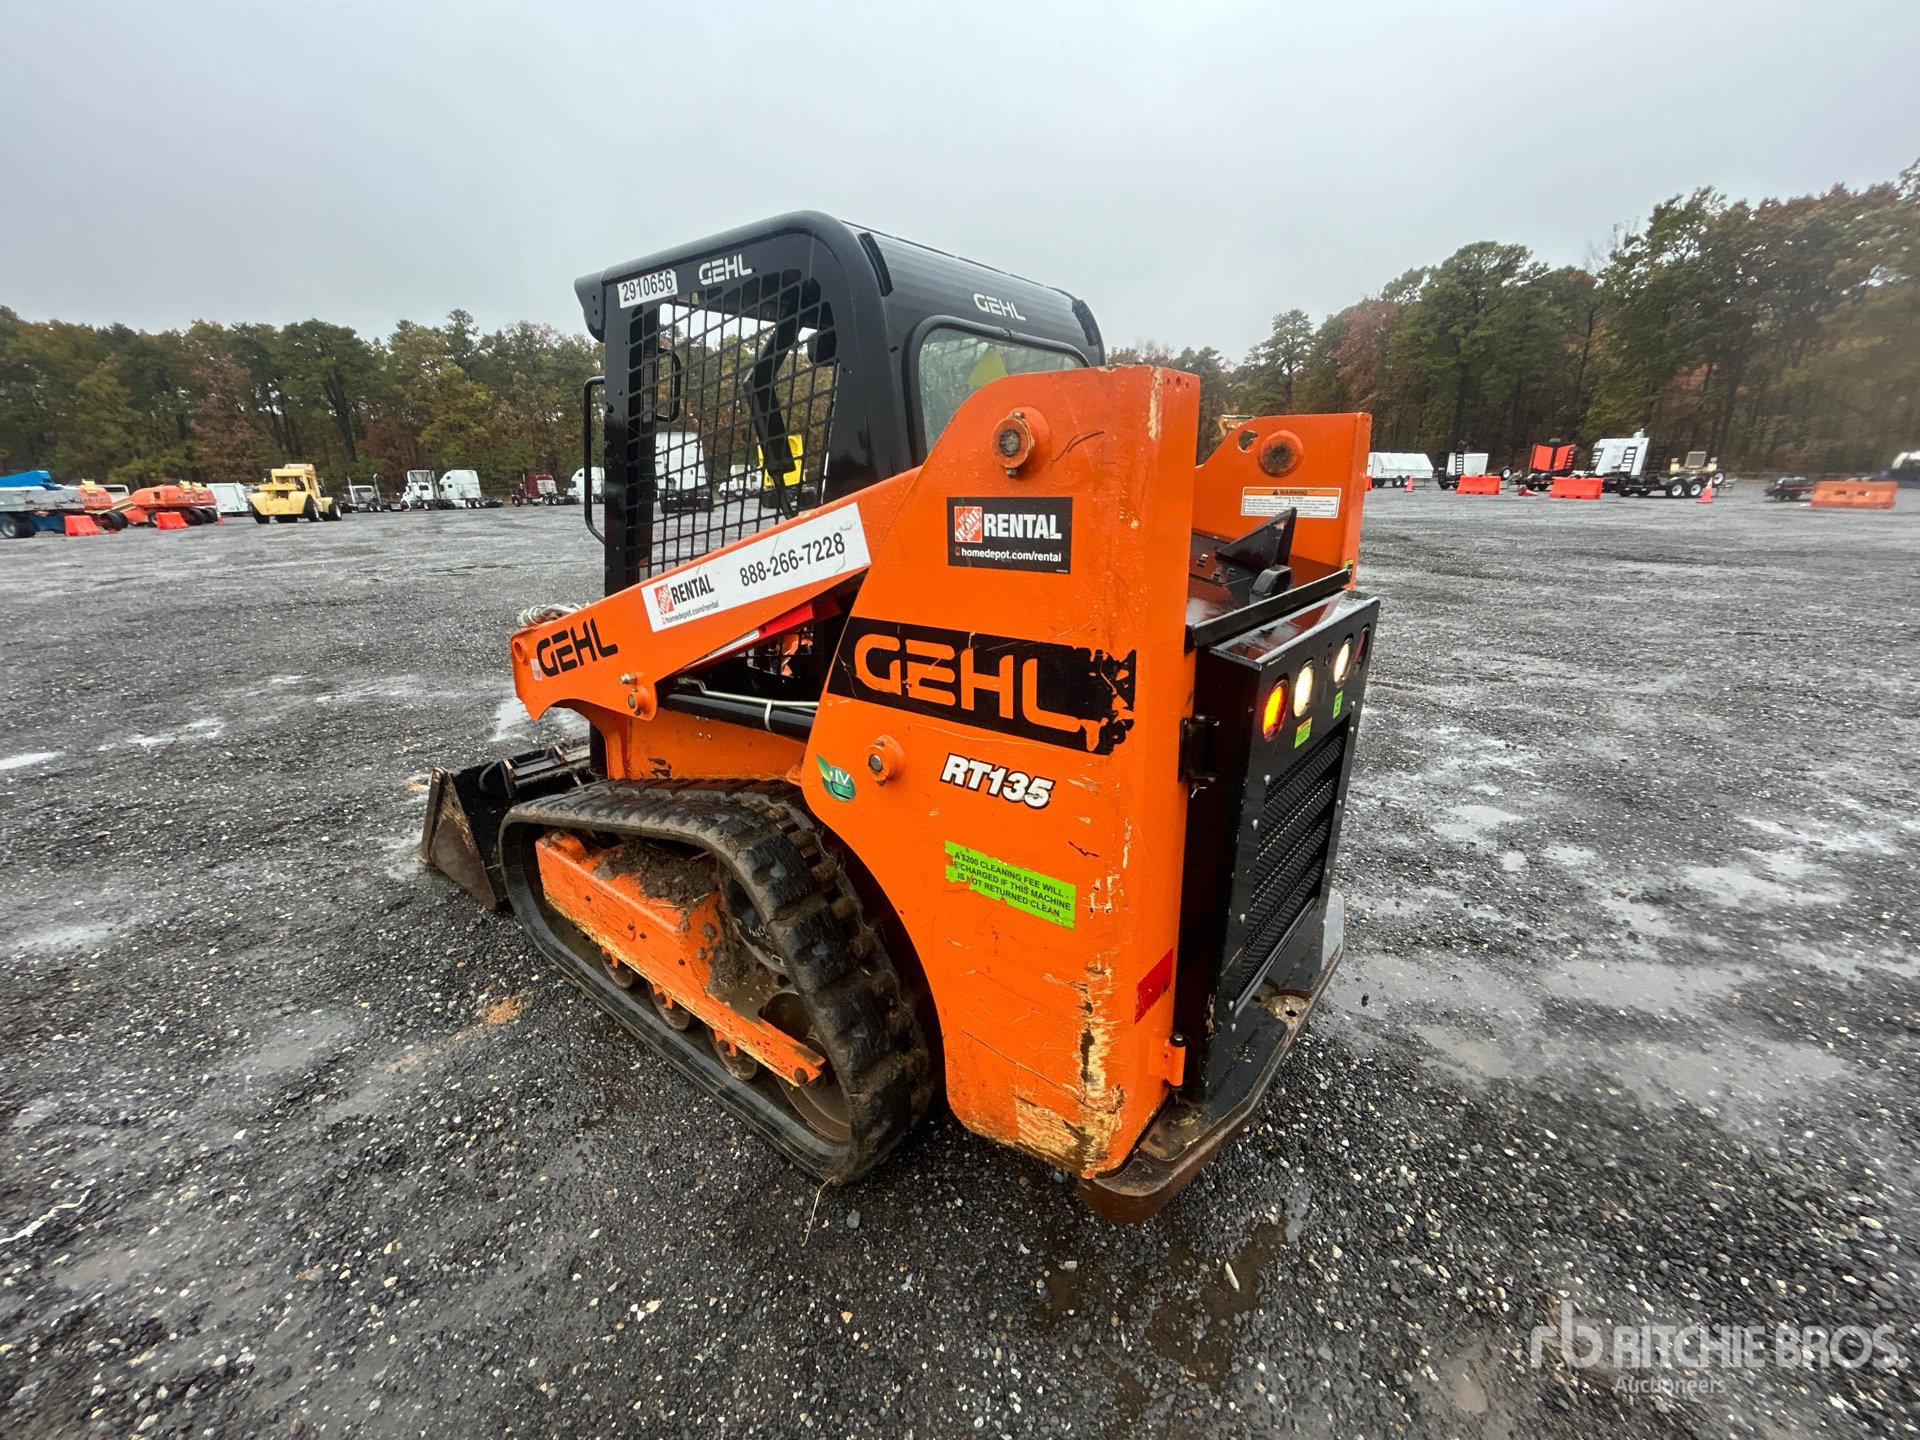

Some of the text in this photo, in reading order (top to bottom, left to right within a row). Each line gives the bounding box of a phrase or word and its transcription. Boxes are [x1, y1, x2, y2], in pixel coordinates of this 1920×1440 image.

[622, 270, 673, 302] 2910656
[698, 254, 752, 286] GEHL
[973, 292, 1026, 321] GEHL
[984, 513, 1062, 539] RENTAL
[740, 532, 846, 587] 888-266-7228
[961, 547, 1062, 562] homedepot.com/rental
[670, 574, 715, 605] RENTAL
[664, 600, 720, 625] homedepot.com/rental
[536, 617, 618, 677] GEHL
[854, 633, 1081, 733] GEHL
[940, 752, 1056, 810] RT135
[960, 863, 998, 884] CHARGED
[1000, 878, 1008, 886] IF
[1010, 880, 1029, 895] THIS
[1030, 890, 1072, 911] MACHINE
[961, 852, 979, 867] $200
[980, 860, 1022, 882] CLEANING
[1024, 876, 1041, 889] FEE
[1042, 882, 1064, 898] WILL
[957, 872, 965, 880] IS
[984, 882, 1028, 905] RETURNED
[1030, 900, 1060, 918] CLEAN
